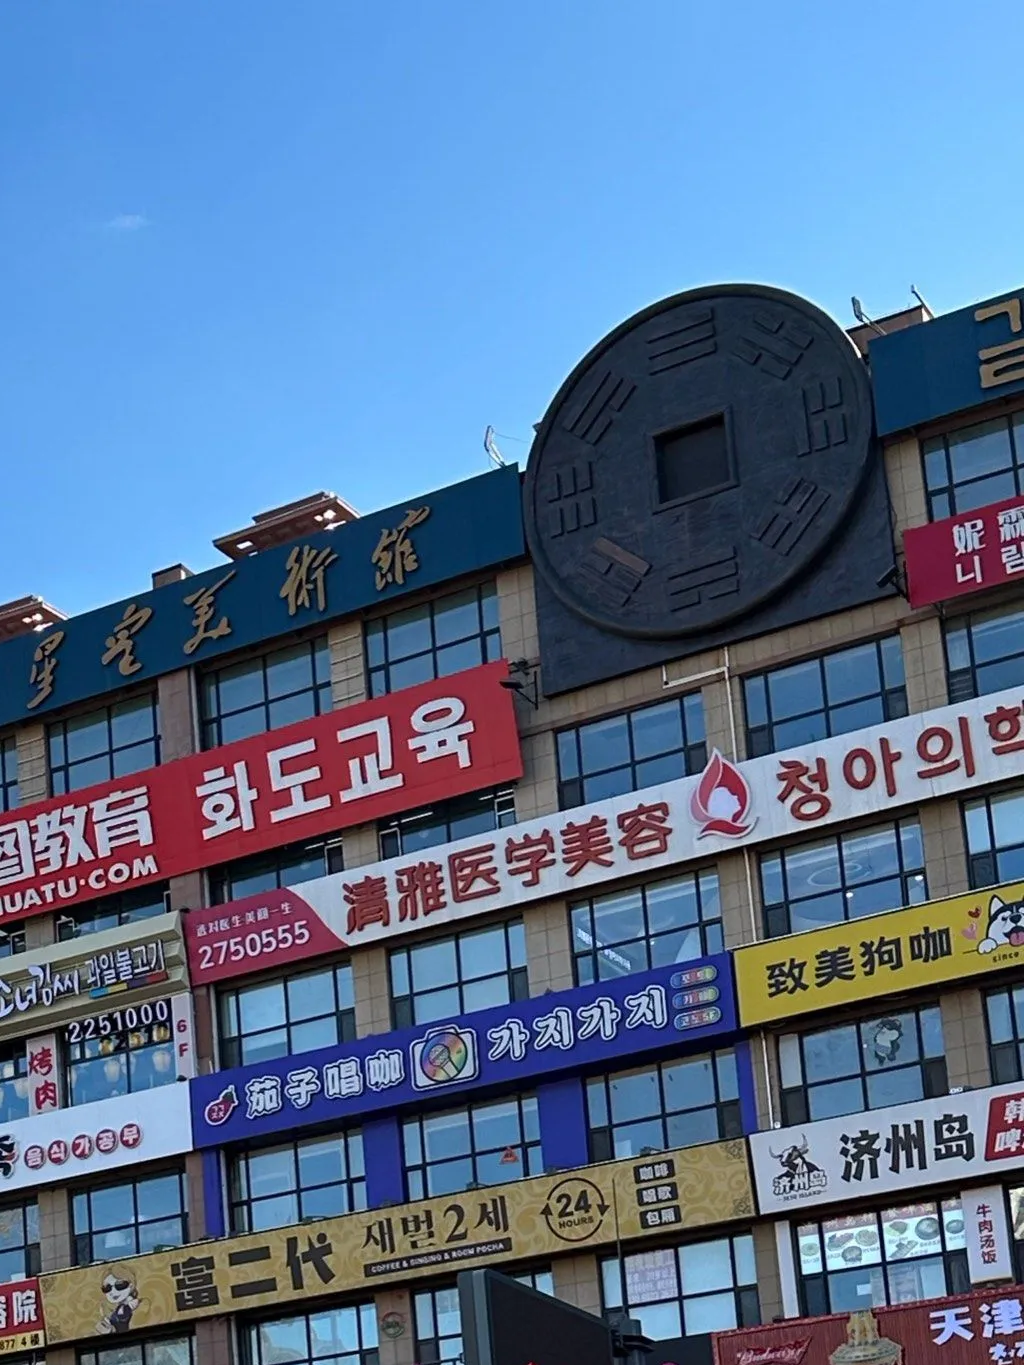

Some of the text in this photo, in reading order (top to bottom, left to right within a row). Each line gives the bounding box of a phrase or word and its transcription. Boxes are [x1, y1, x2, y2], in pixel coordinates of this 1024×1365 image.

[196, 696, 474, 842] 화도교육
[343, 802, 674, 936] 清雅医学美容
[86, 942, 166, 990] 과일불고기
[198, 920, 311, 970] 2750555
[766, 926, 953, 999] 致美狗咖
[67, 1000, 169, 1043] 2251000
[486, 984, 669, 1065] 가지가지
[28, 1045, 58, 1112] 烤肉
[243, 1046, 405, 1119] 茄子唱咖
[24, 1121, 143, 1172] 음식가공부
[839, 1113, 975, 1183] 济州岛
[555, 1188, 592, 1218] 24
[772, 1169, 827, 1196] 济州岛
[361, 1195, 510, 1254] 재벌2세
[558, 1214, 594, 1231] HOURS
[976, 1203, 998, 1265] 牛肉汤饭
[171, 1231, 336, 1311] 富二代
